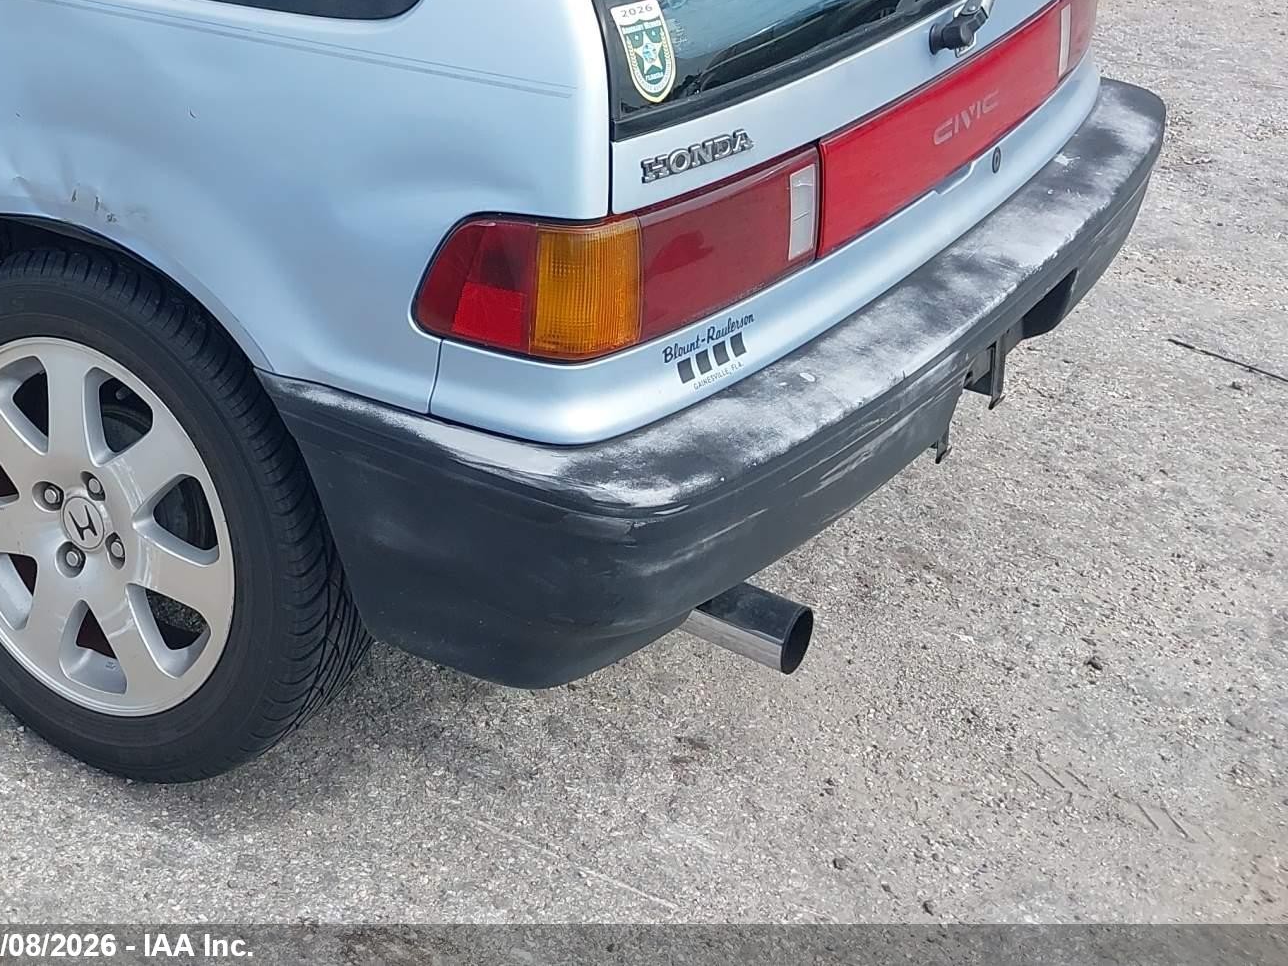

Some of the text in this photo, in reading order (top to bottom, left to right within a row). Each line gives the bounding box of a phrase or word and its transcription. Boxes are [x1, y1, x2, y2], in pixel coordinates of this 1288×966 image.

[620, 4, 653, 18] 2026
[933, 88, 999, 145] CIVIC
[640, 129, 753, 184] HONDA
[662, 314, 754, 363] Blount-Raulerson
